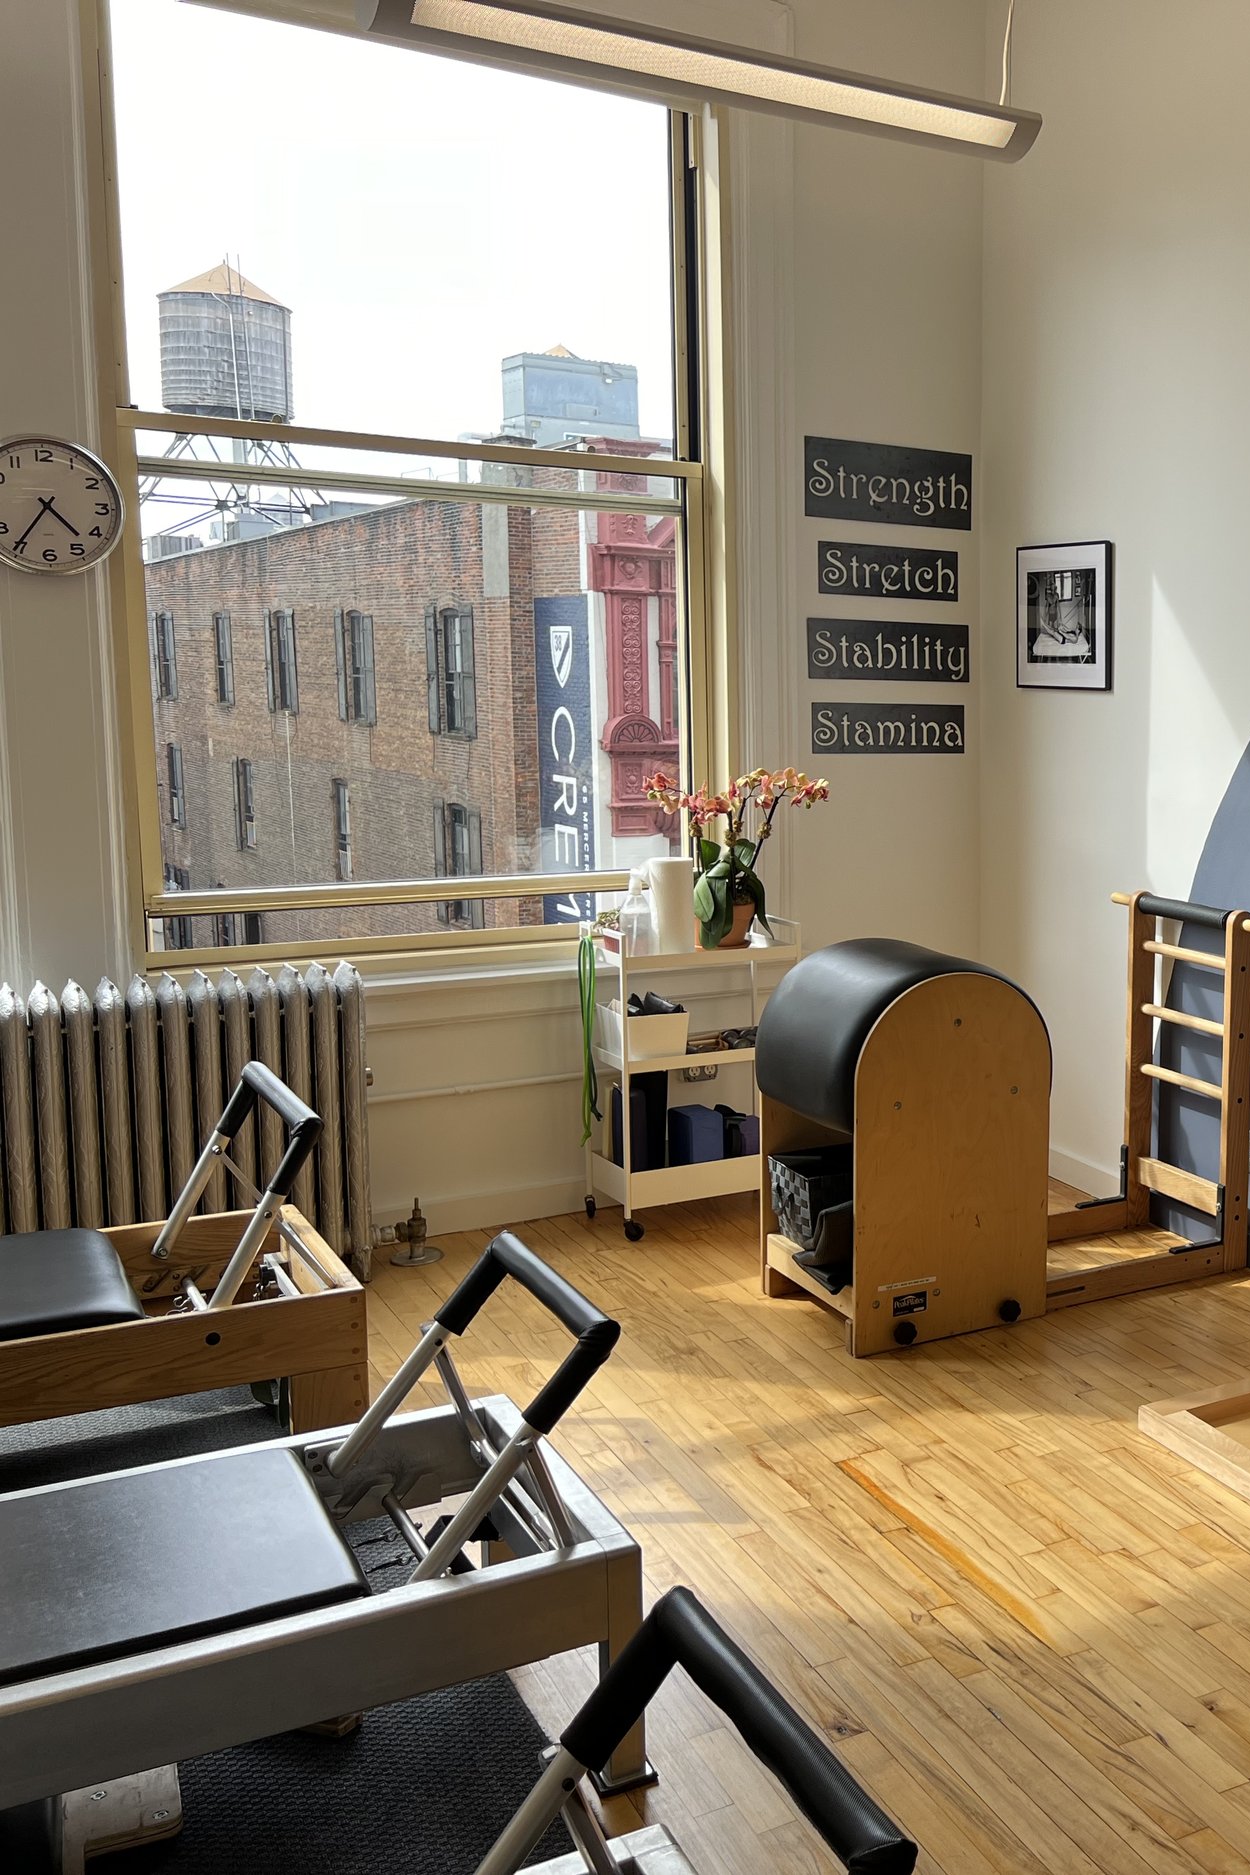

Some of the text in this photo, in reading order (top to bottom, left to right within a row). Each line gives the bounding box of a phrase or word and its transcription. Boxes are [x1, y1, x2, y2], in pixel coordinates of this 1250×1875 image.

[10, 455, 21, 469] 11
[35, 449, 54, 463] 12
[69, 457, 74, 470] 1
[84, 477, 100, 490] 2
[808, 458, 969, 517] Strength
[94, 502, 110, 516] 3
[88, 525, 103, 539] 4
[42, 549, 58, 562] 6
[70, 543, 85, 556] 5
[822, 549, 956, 595] Stretch
[812, 630, 966, 680] Stability
[813, 710, 964, 747] Stamina
